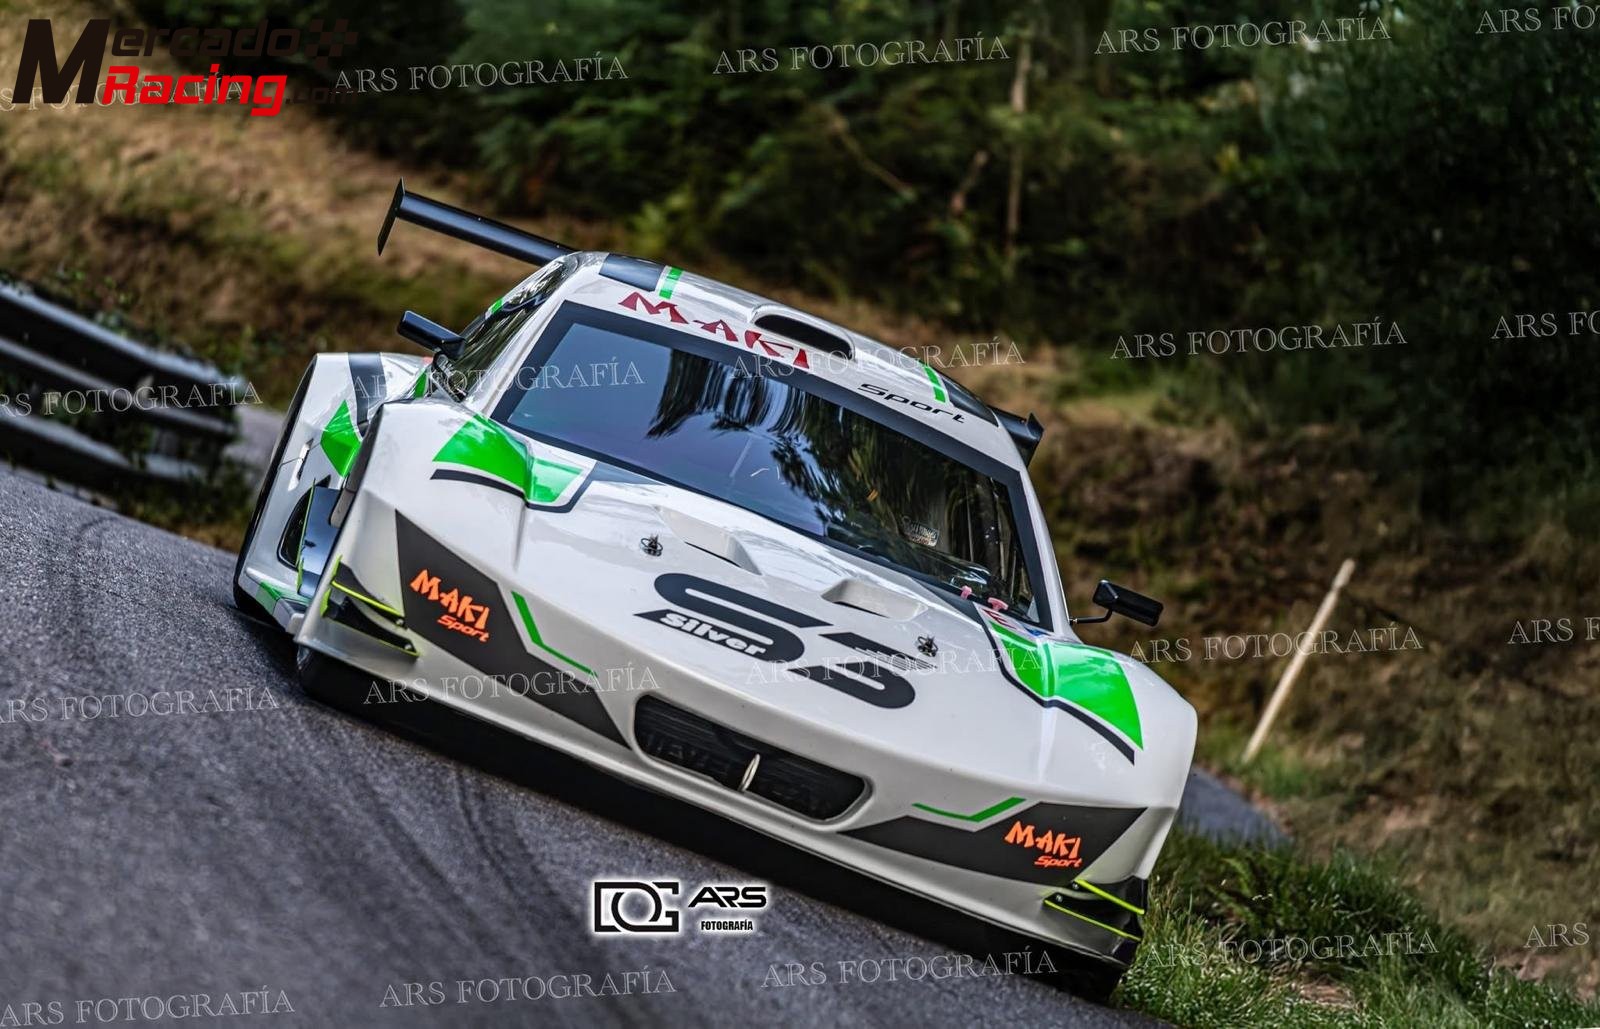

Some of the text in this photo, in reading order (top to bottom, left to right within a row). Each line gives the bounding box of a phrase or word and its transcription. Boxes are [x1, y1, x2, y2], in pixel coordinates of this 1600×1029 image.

[618, 292, 809, 368] MAKI
[858, 383, 964, 424] Sport
[410, 569, 489, 629] MAKI
[437, 614, 489, 642] Sport
[660, 612, 767, 656] Silver
[1005, 821, 1081, 859] MAKI
[1034, 856, 1082, 867] Sport
